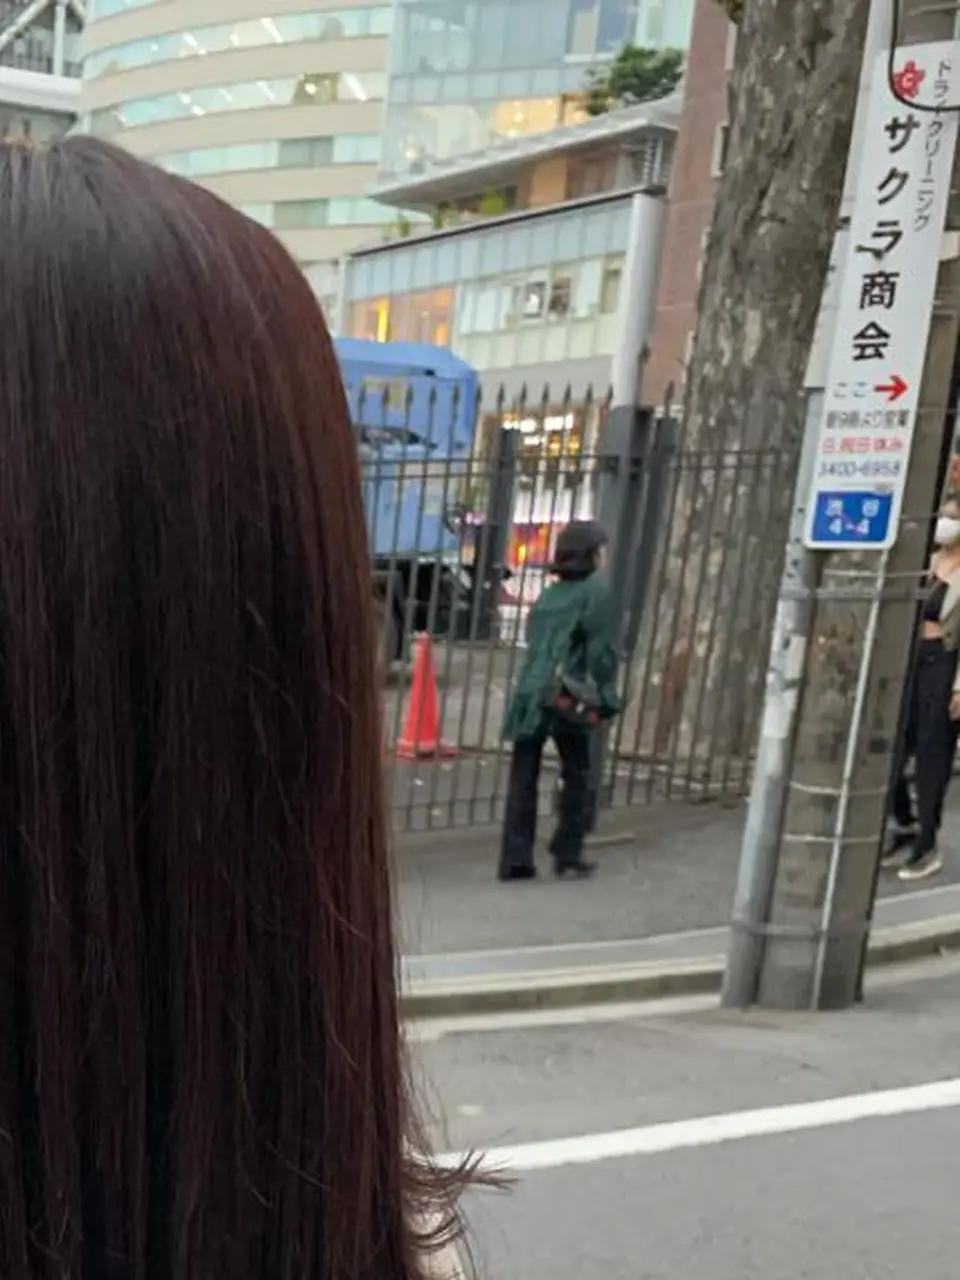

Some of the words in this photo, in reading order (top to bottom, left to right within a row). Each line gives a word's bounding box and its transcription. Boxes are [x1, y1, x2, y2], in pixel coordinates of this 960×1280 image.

[852, 113, 920, 361] サクラ商会
[833, 381, 868, 399] ここ
